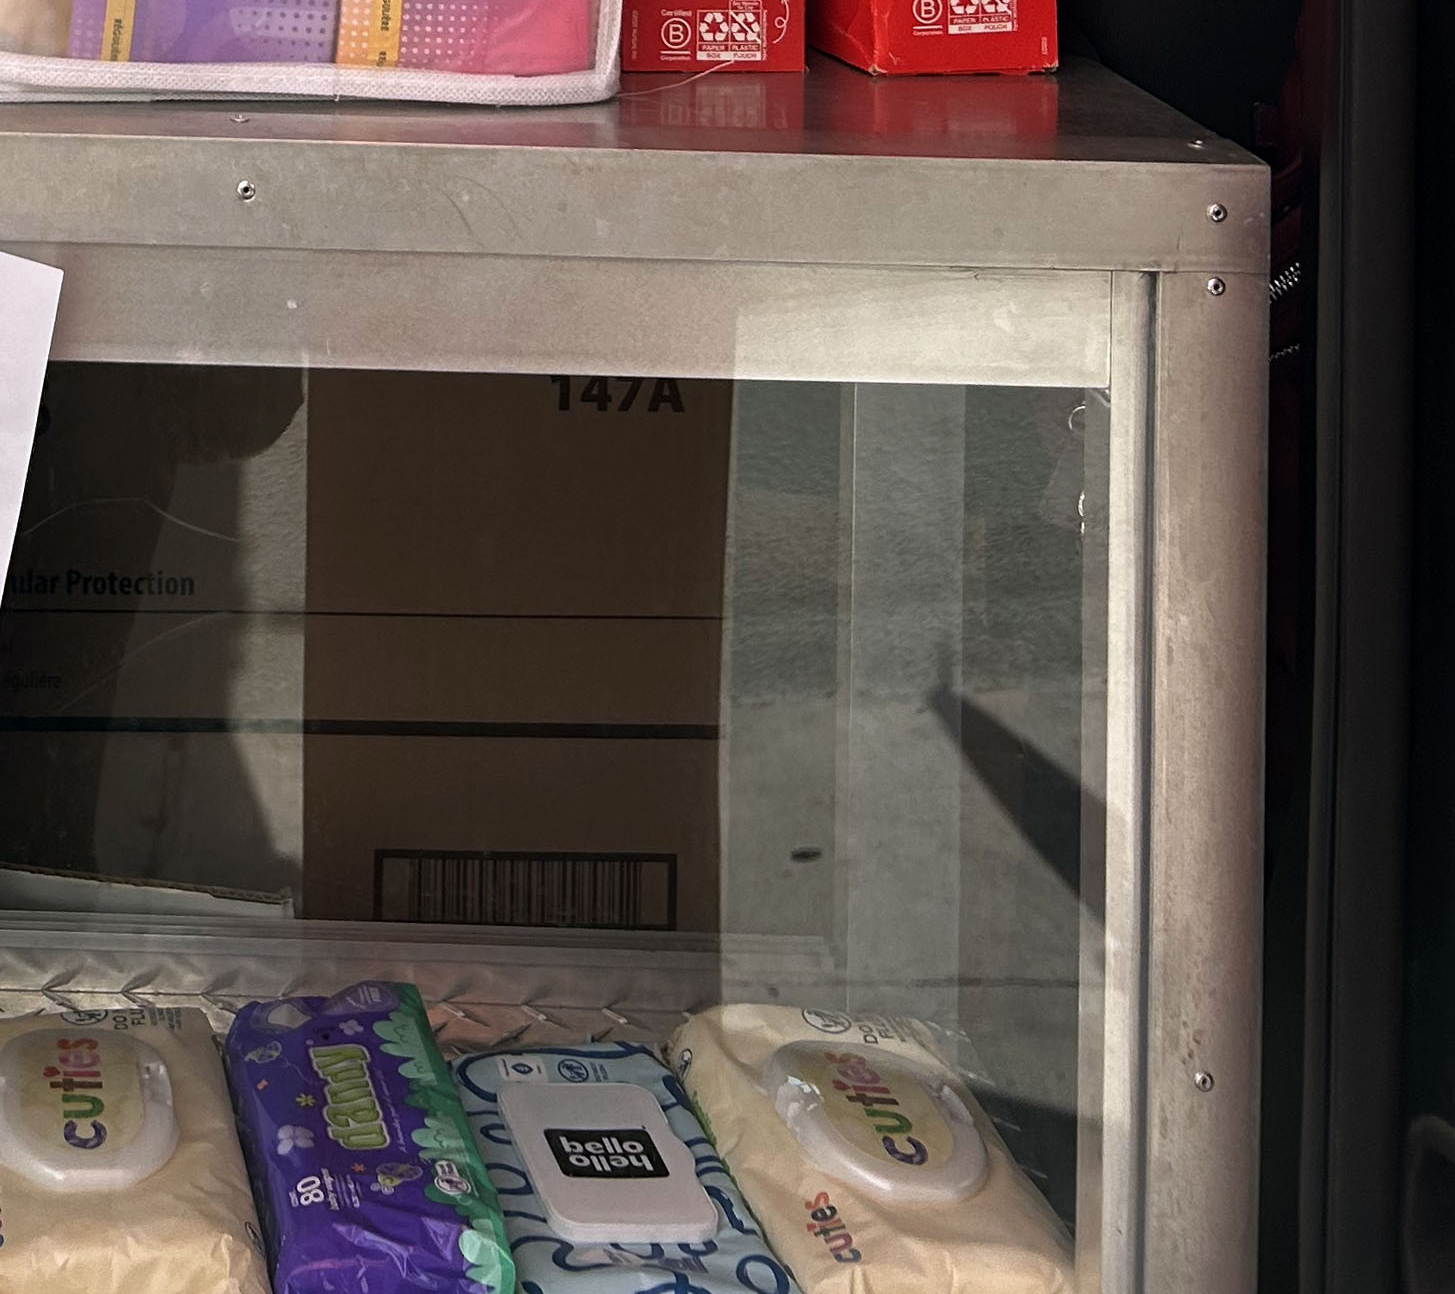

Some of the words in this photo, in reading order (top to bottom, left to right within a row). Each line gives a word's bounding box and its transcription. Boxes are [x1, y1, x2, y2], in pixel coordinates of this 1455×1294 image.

[921, 0, 935, 17] B
[669, 24, 684, 42] B
[550, 376, 685, 412] 147A
[67, 569, 195, 596] Protection
[43, 1038, 107, 1149] cuties
[826, 1051, 929, 1166] cuties
[559, 1136, 644, 1154] bello
[569, 1154, 654, 1172] hello
[296, 1175, 324, 1206] 80
[805, 1192, 862, 1263] cuties
